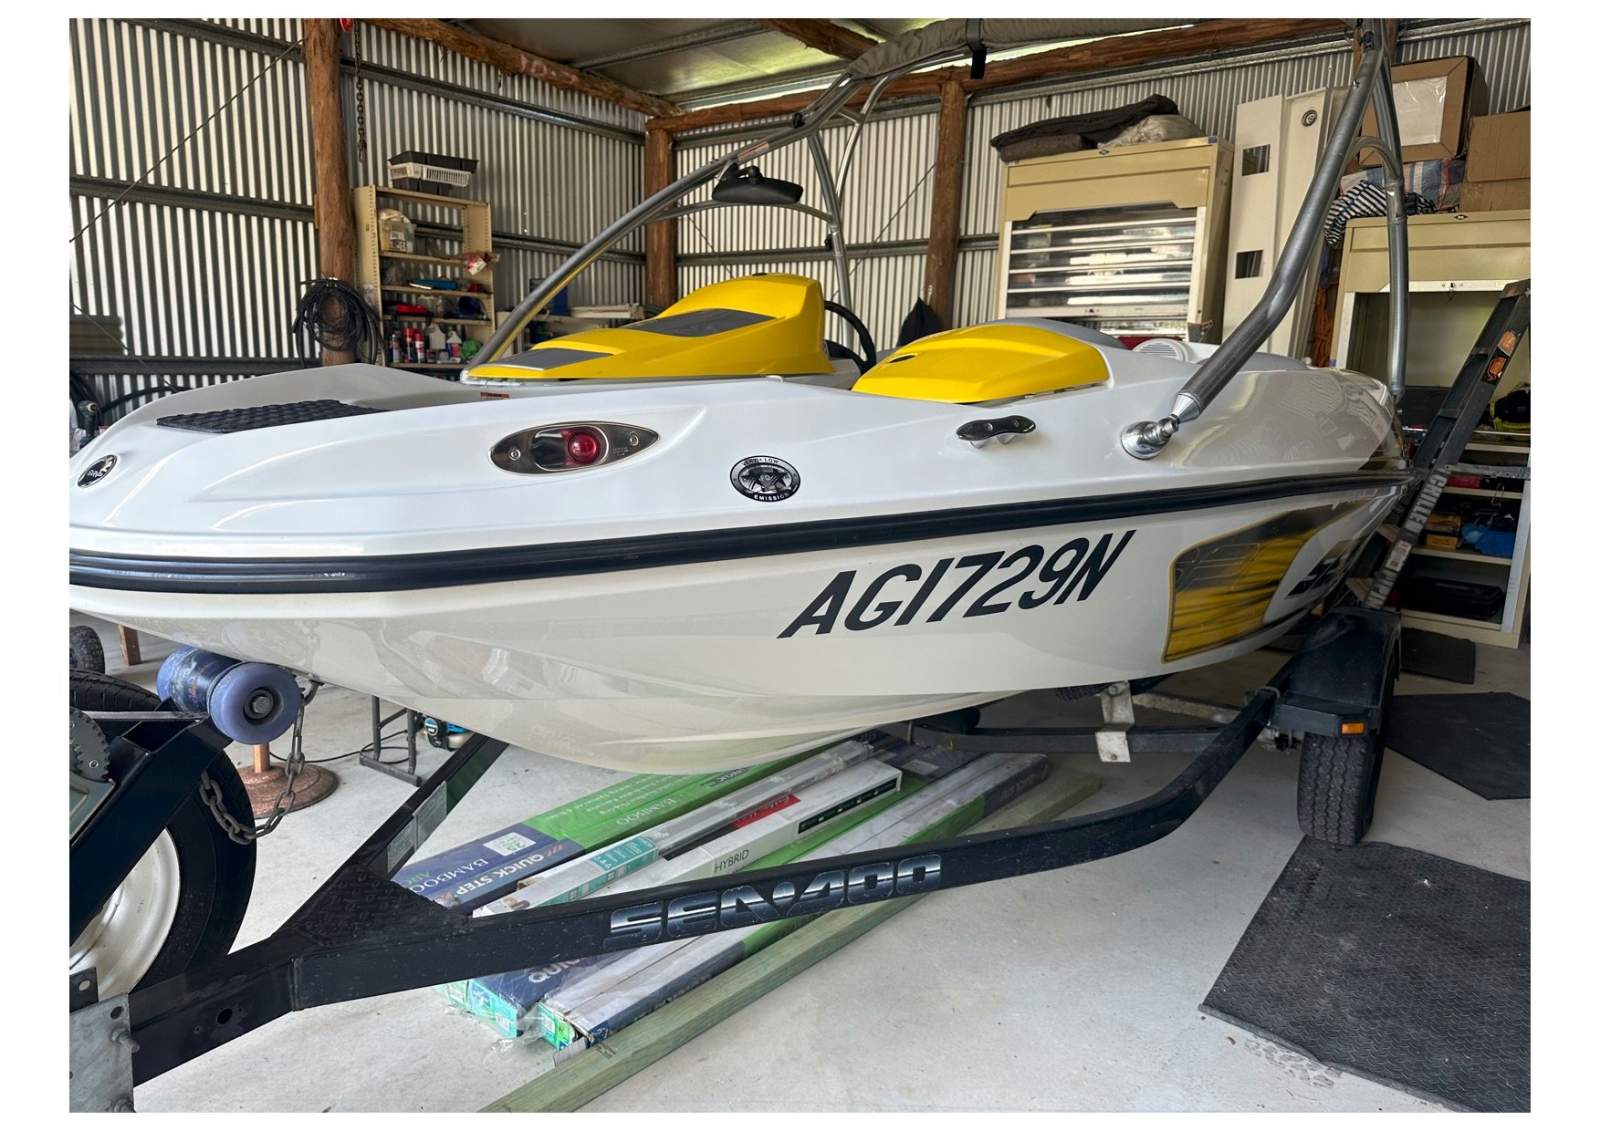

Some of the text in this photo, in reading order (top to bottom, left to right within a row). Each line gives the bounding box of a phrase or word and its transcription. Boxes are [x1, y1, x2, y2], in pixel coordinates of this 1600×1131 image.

[455, 854, 545, 896] QUICK STEP
[713, 849, 751, 873] HYBRID
